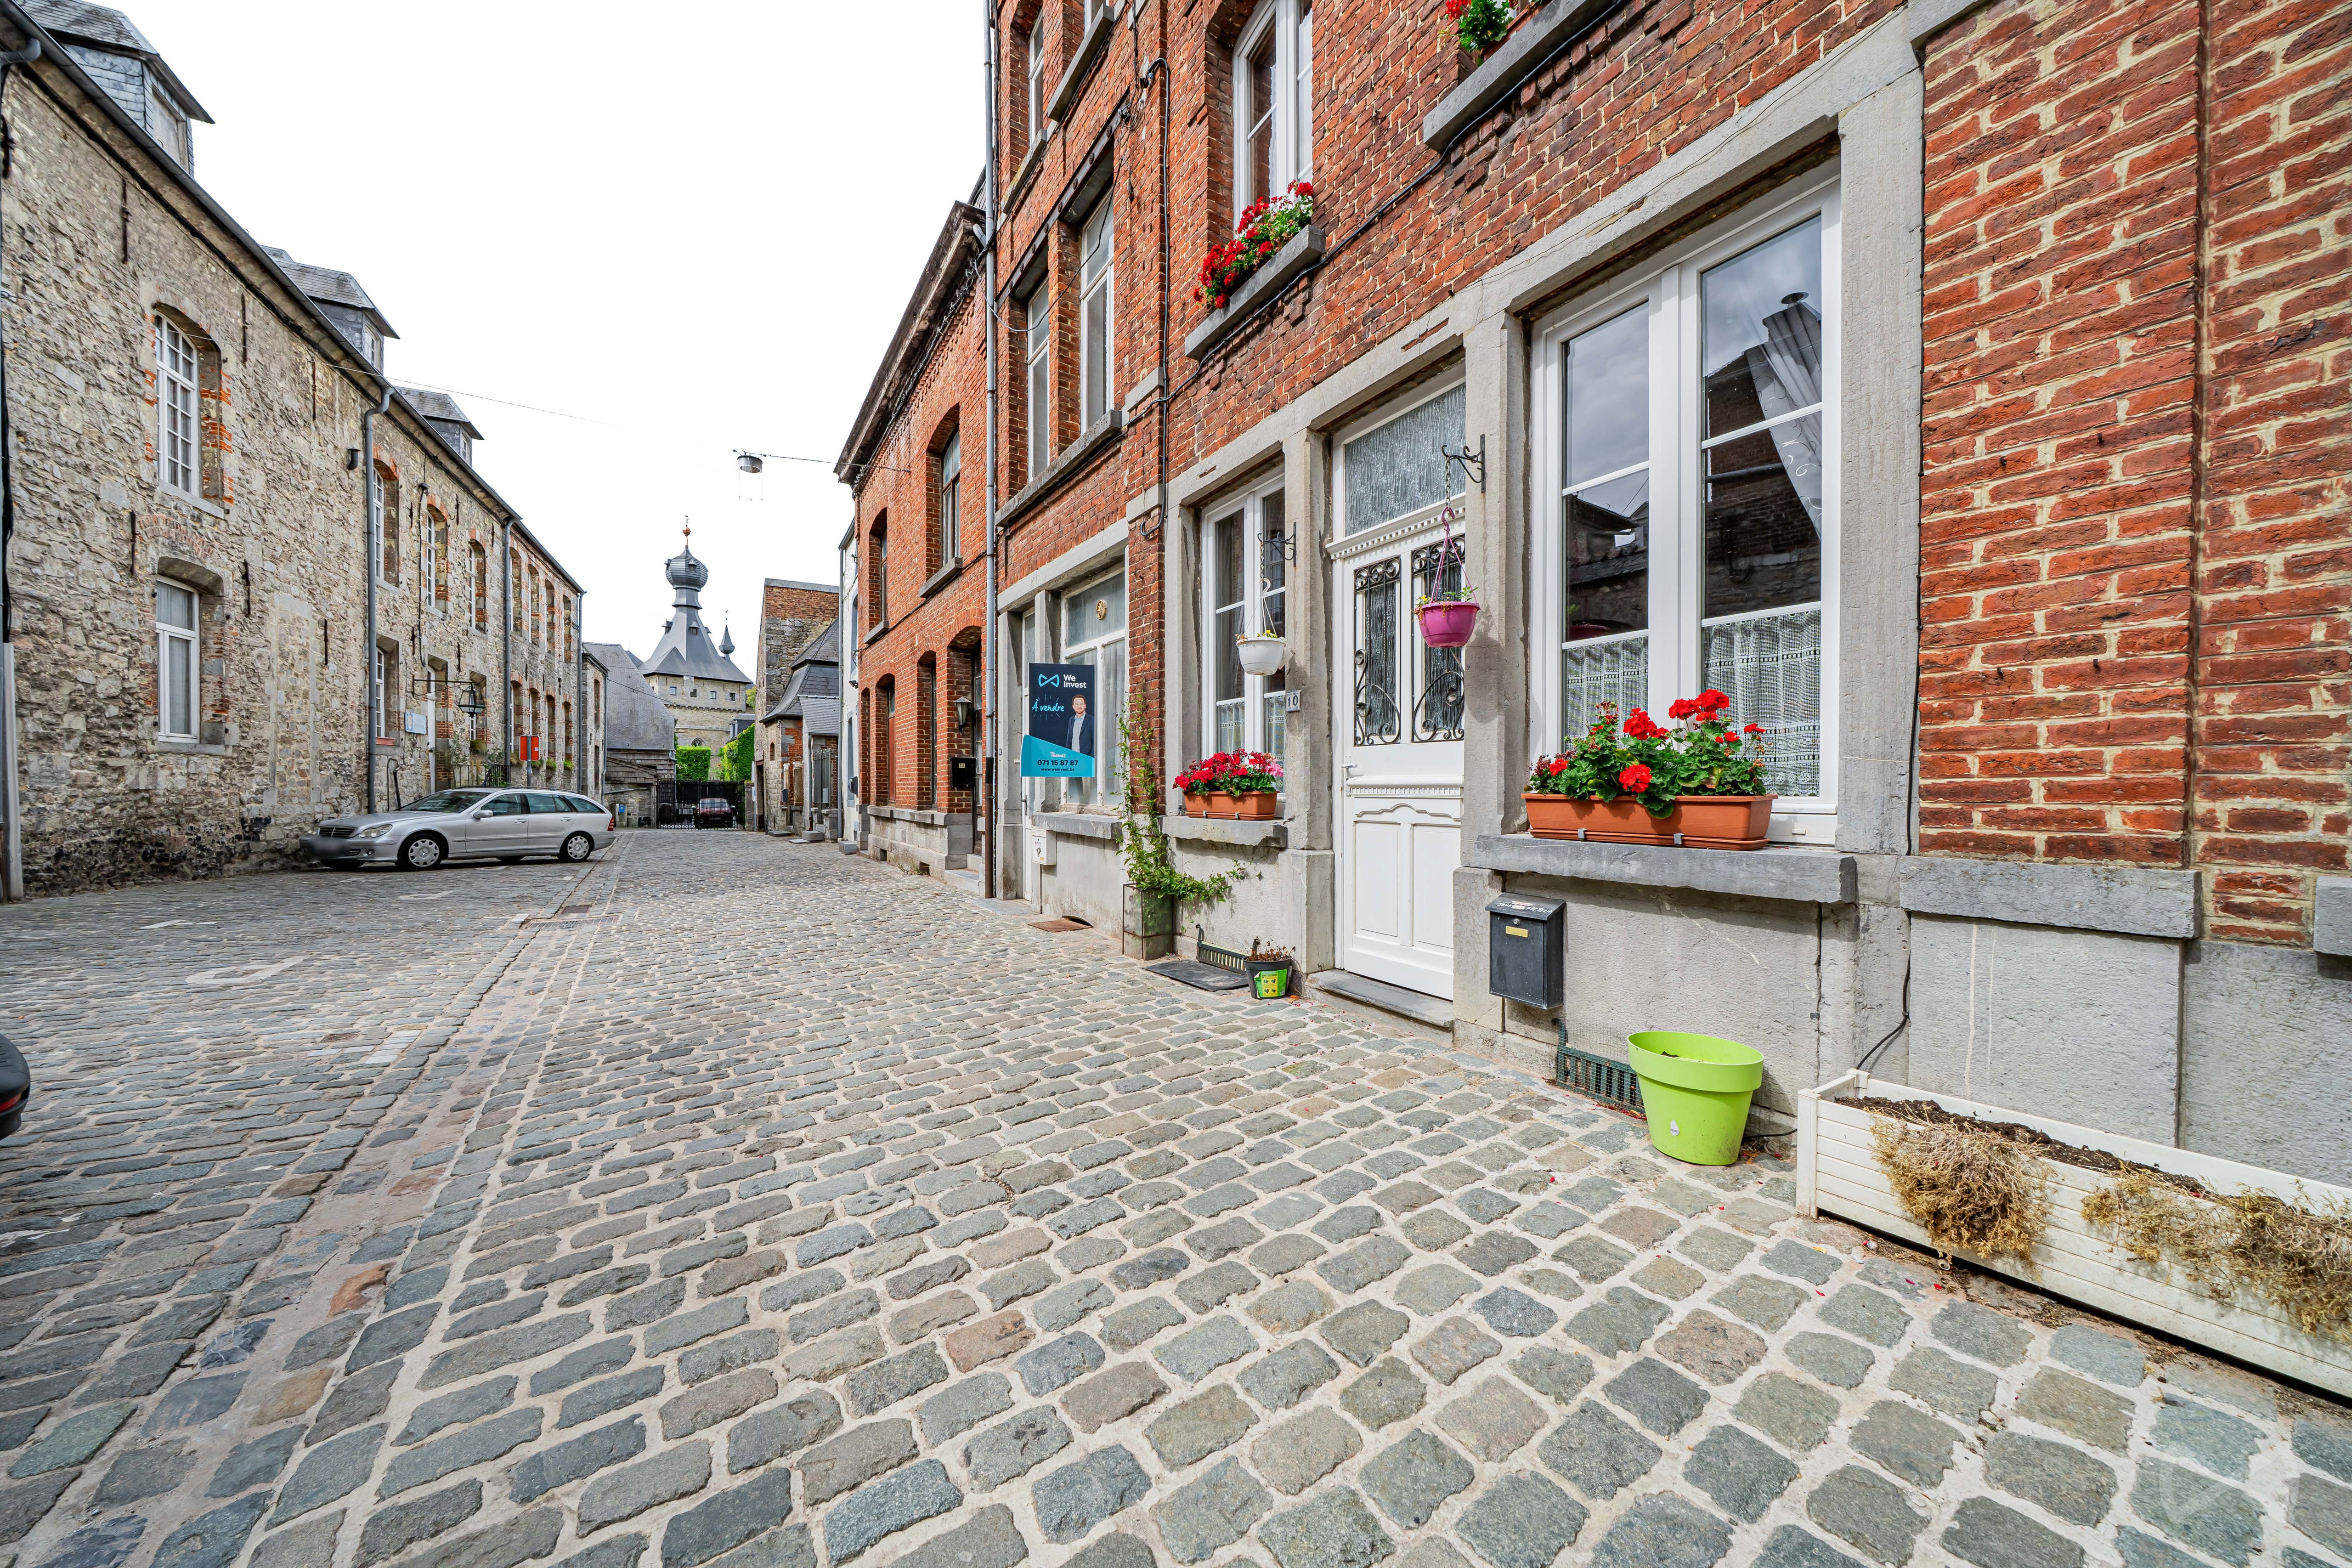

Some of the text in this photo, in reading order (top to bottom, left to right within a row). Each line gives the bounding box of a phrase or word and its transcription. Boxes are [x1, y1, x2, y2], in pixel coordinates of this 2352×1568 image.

[1032, 698, 1064, 712] À vendre
[1288, 695, 1298, 707] 10
